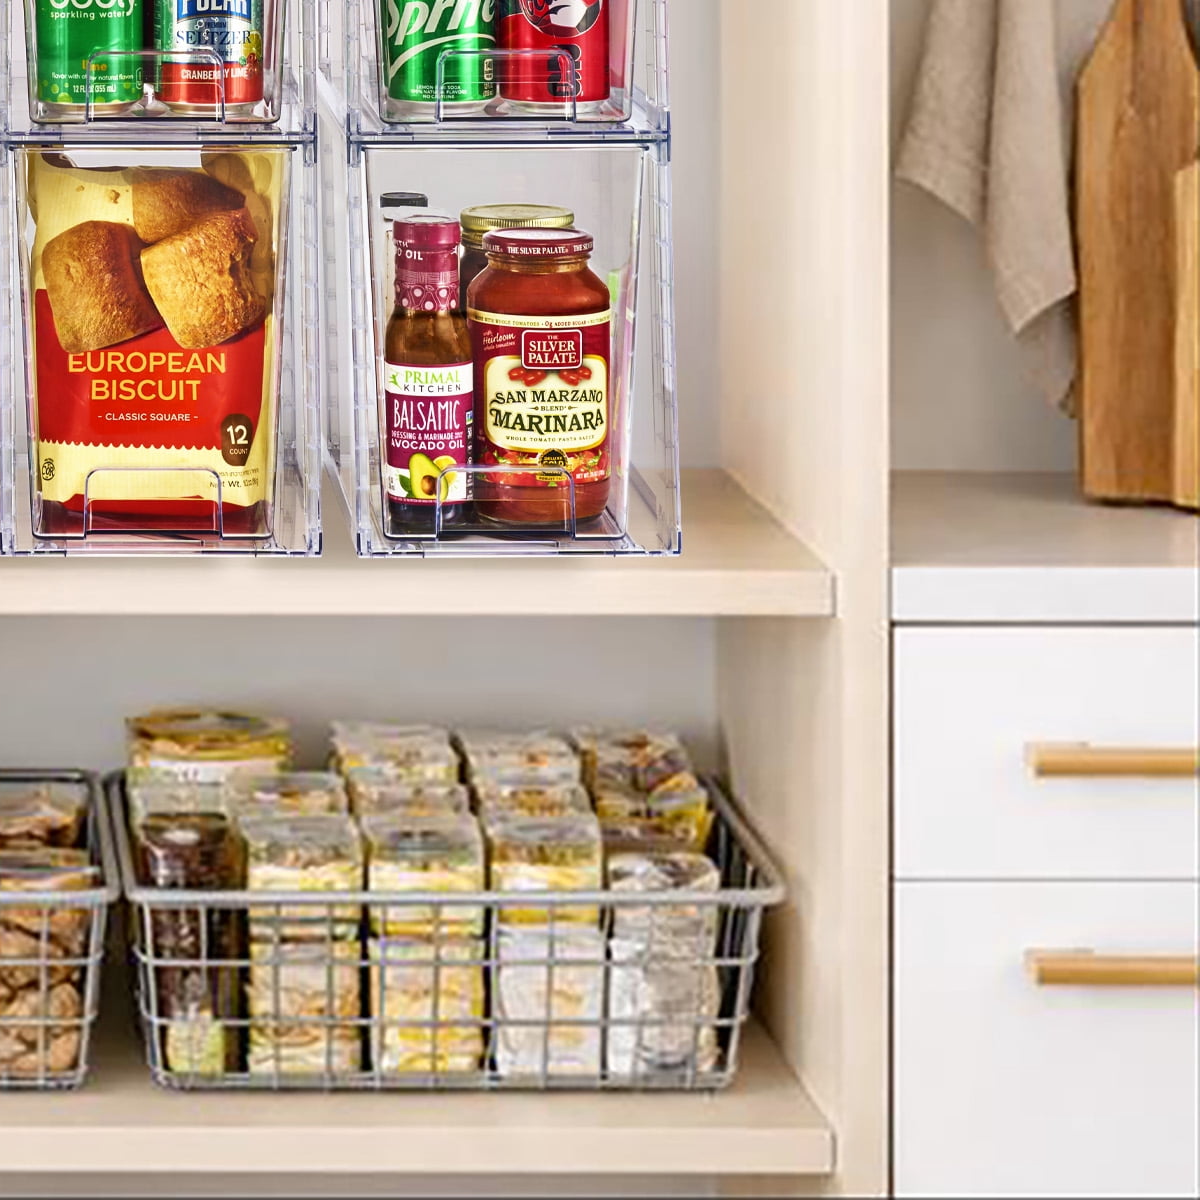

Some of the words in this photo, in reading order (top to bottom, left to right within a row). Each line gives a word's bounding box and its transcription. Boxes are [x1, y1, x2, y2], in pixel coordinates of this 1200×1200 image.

[50, 10, 96, 21] sparkling
[99, 11, 128, 19] water
[176, 30, 251, 45] SELTZER
[230, 68, 249, 78] LIME
[73, 85, 79, 93] 12
[405, 250, 424, 260] OIL
[507, 246, 519, 254] THE
[520, 247, 541, 255] SILVER
[542, 246, 565, 255] PALATE
[544, 320, 553, 328] 0g
[483, 332, 515, 344] Heirloom
[529, 340, 575, 352] SILVER
[68, 351, 227, 374] EUROPEAN
[528, 352, 577, 364] PALATE
[404, 370, 462, 384] PRIMAL
[91, 379, 202, 401] BISCUIT
[403, 384, 462, 393] KITCHEN
[490, 390, 527, 405] SAN
[531, 389, 603, 404] MARZANO
[105, 412, 147, 422] CLASSIC
[150, 412, 191, 422] SQUARE
[393, 399, 461, 431] BALSAMIC
[489, 408, 605, 435] MARINARA
[226, 424, 249, 445] 12
[423, 432, 454, 441] MARINADE
[448, 439, 465, 449] OIL
